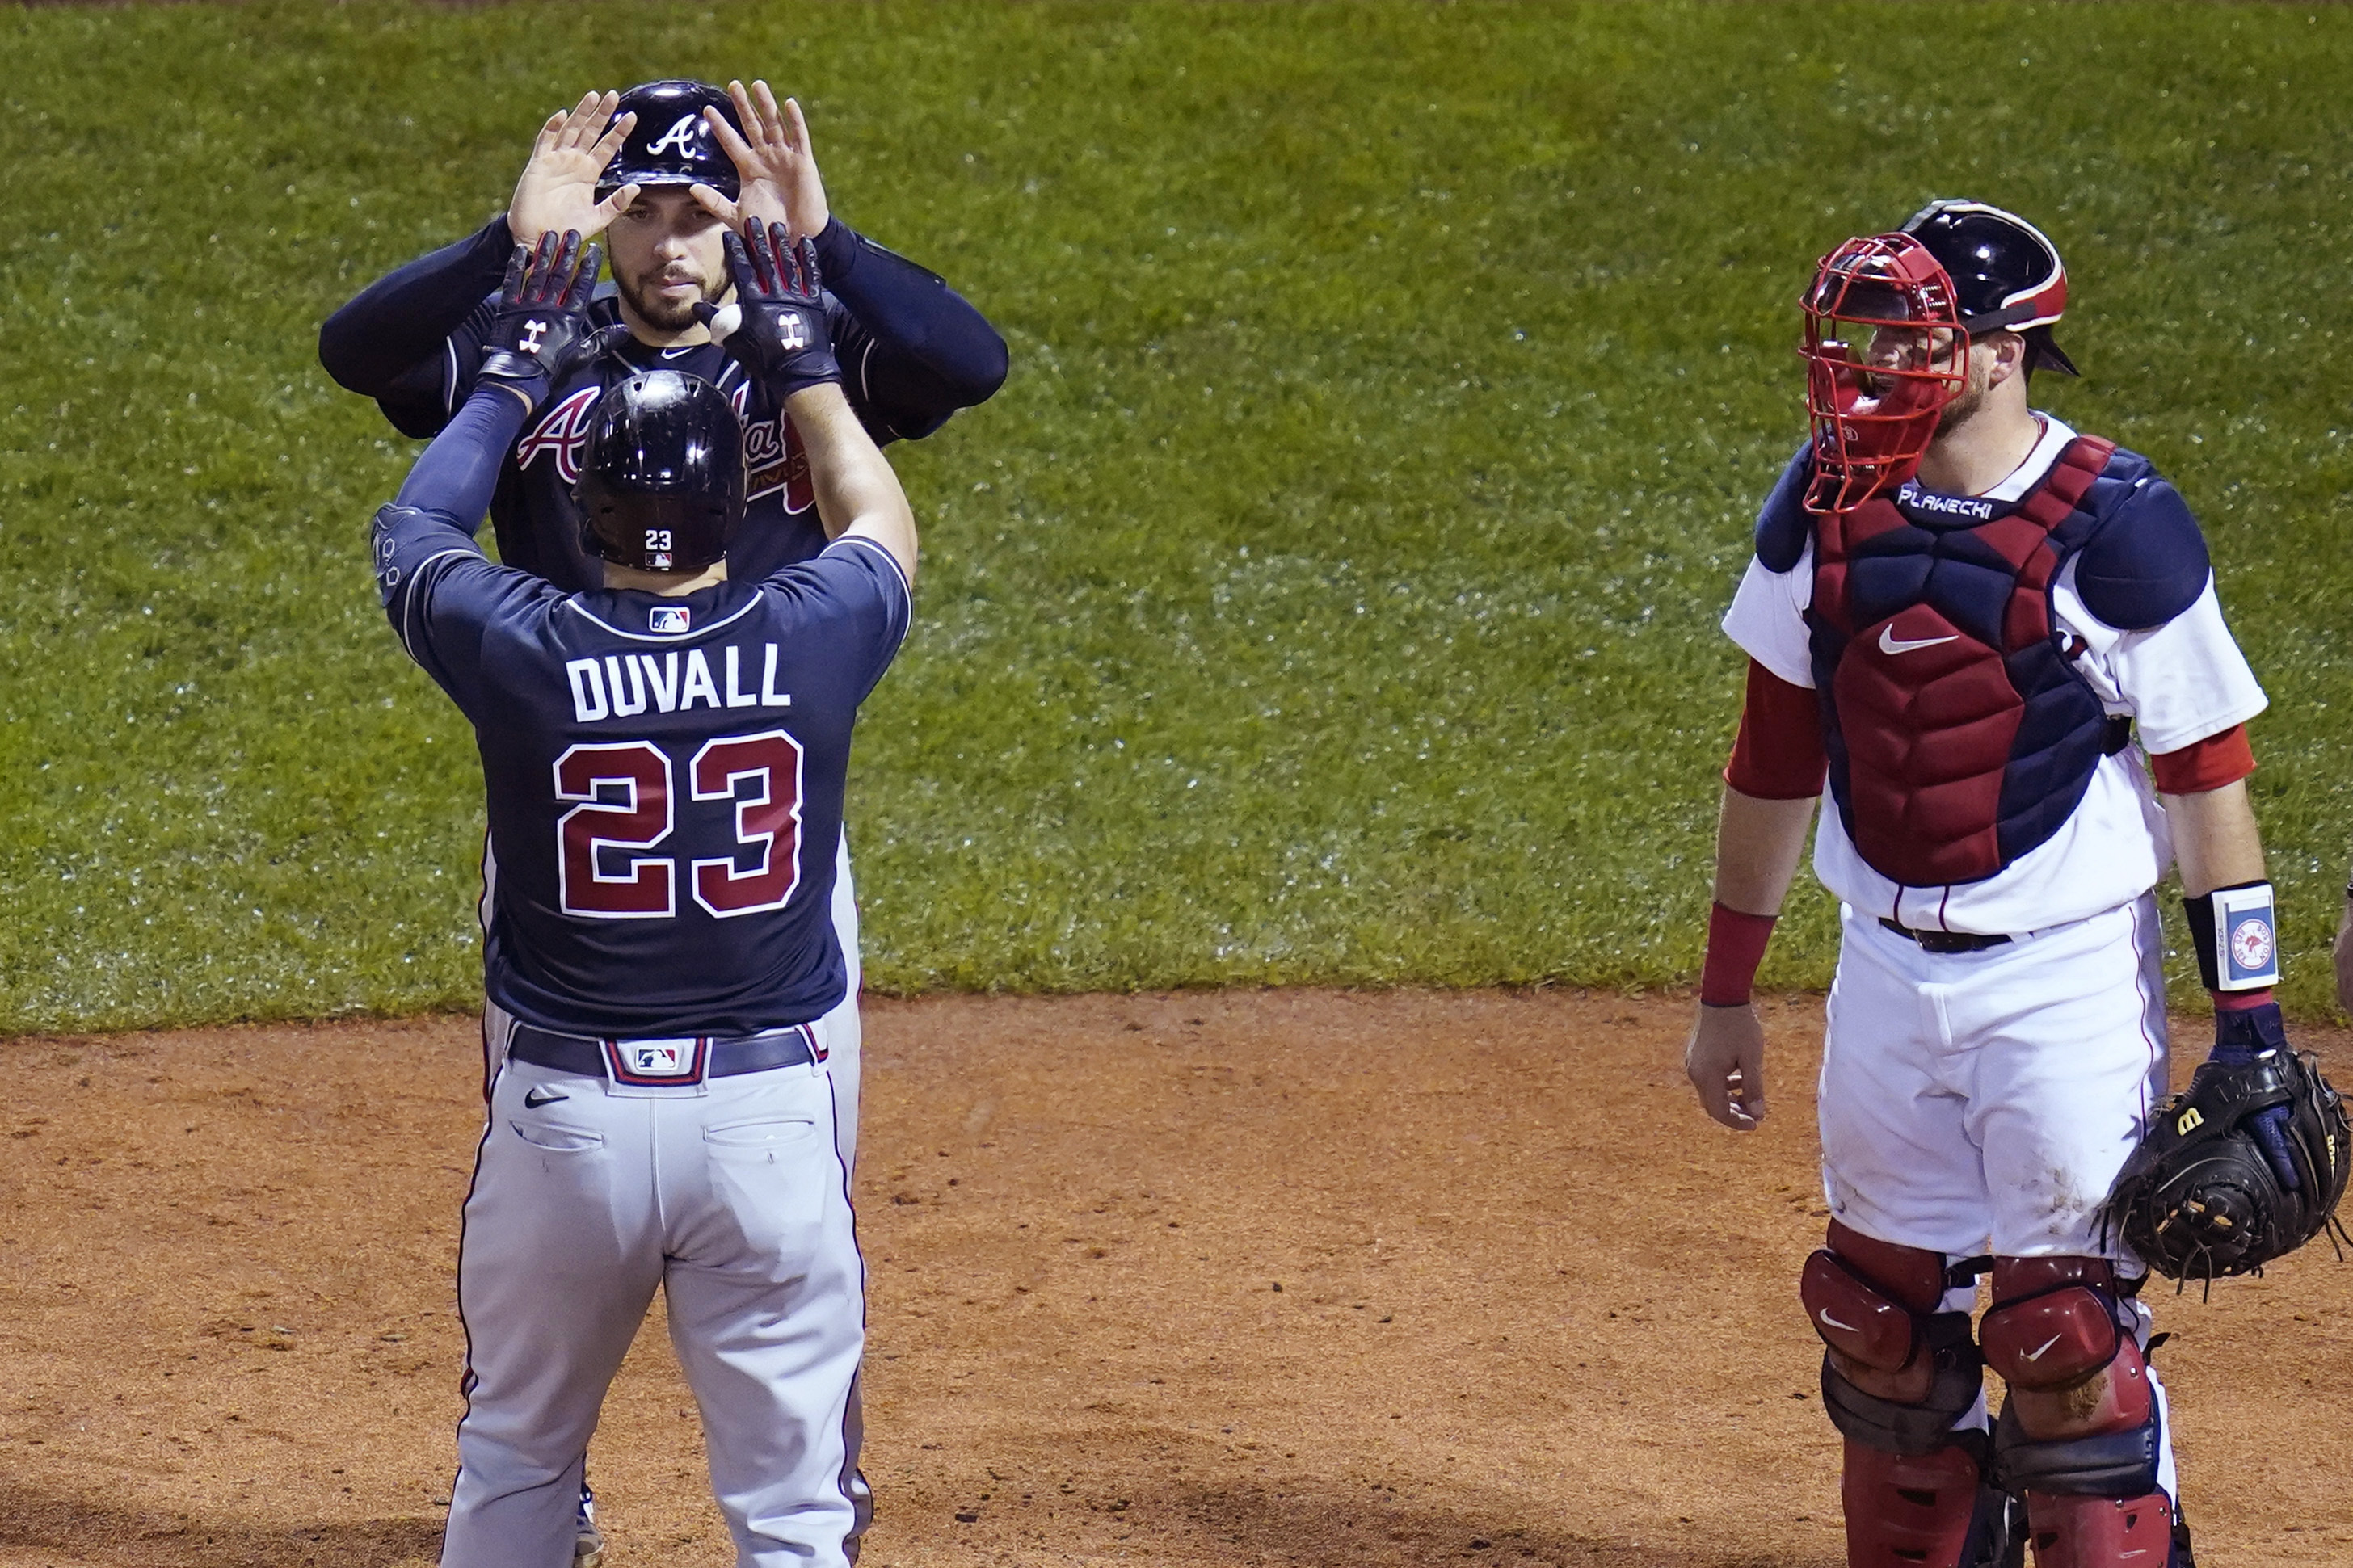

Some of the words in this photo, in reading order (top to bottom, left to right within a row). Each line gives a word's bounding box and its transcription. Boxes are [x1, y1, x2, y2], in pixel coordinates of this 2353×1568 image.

[646, 113, 696, 158] A
[1897, 488, 1993, 519] PLAWECKI
[646, 529, 671, 551] 23
[566, 643, 791, 722] DUVALL
[553, 729, 804, 919] 23
